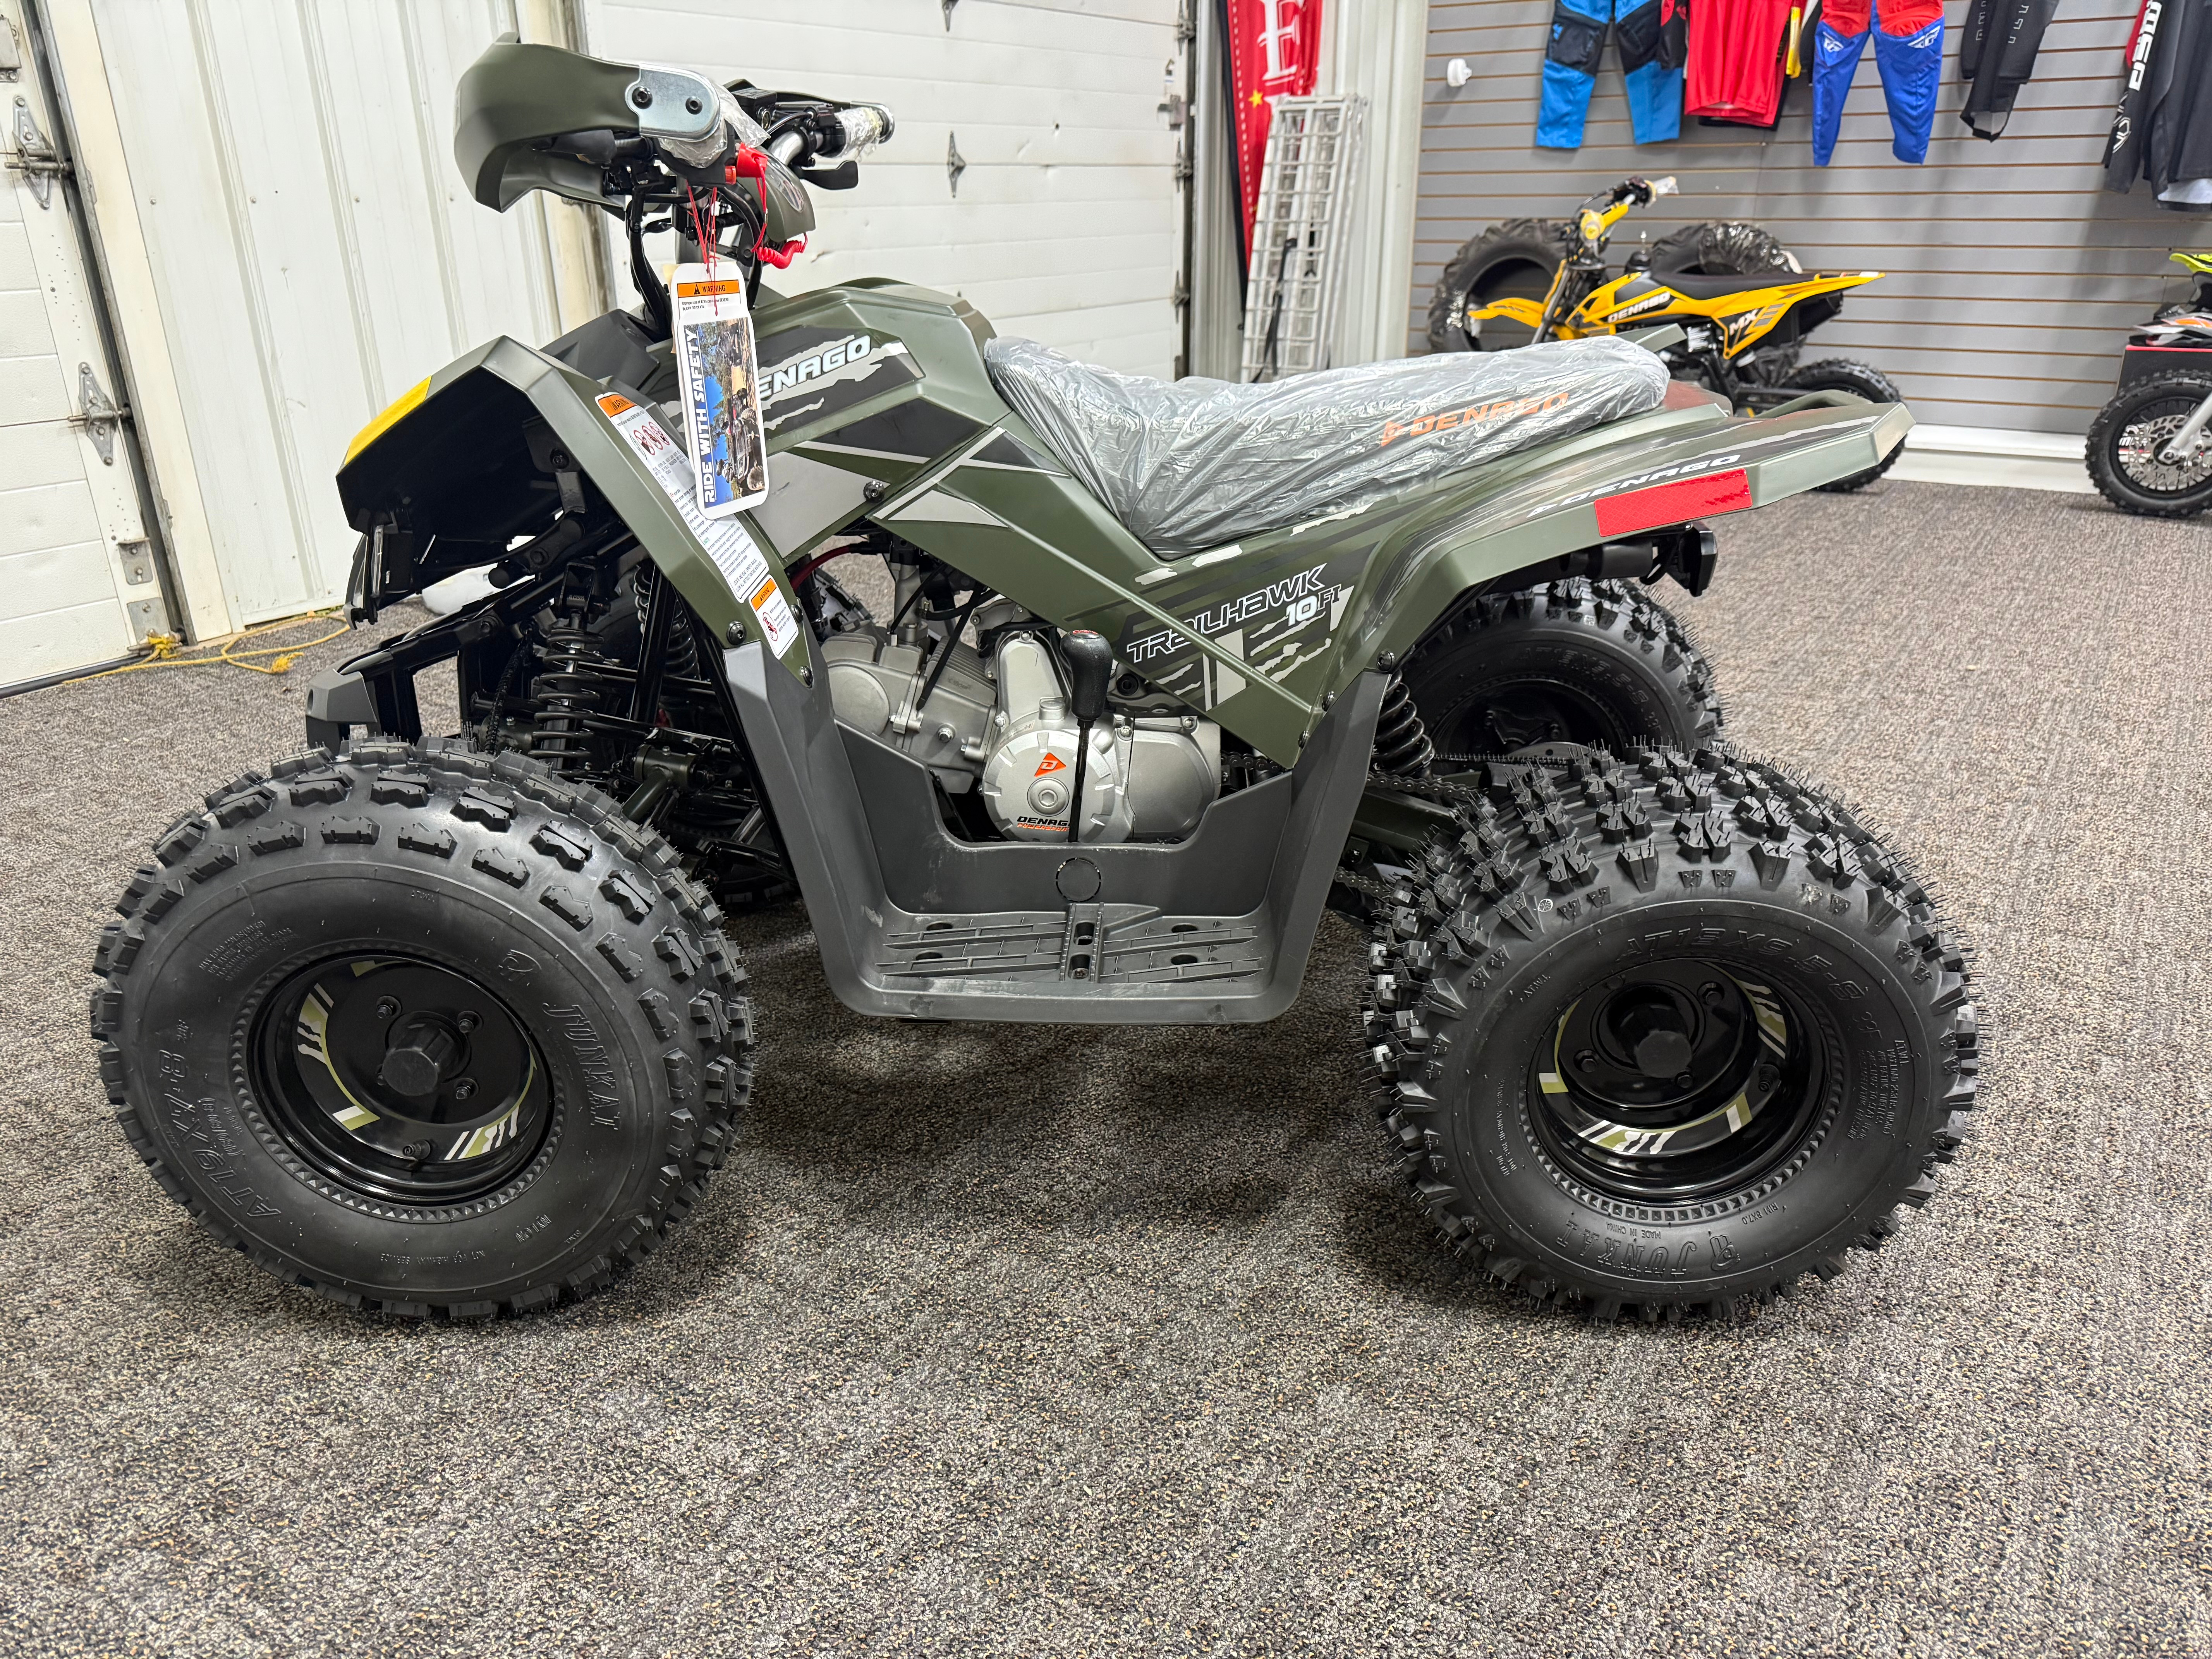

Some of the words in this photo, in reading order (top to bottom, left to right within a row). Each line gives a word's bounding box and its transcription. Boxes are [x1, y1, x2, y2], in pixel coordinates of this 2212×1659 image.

[685, 328, 706, 402] SAFETY
[759, 335, 871, 398] ENAGO
[696, 409, 711, 456] WITH
[703, 461, 715, 503] RIDE
[1558, 454, 1740, 505] DENAGO
[1017, 816, 1070, 827] DENAG
[543, 1001, 620, 1129] JUNKAI
[1741, 1210, 1762, 1225] 8X7.0
[1763, 1202, 1778, 1215] RIM
[514, 1213, 552, 1243] NYLON
[1606, 1221, 1626, 1234] CHINA
[1629, 1228, 1637, 1237] IN
[1640, 1230, 1661, 1239] MADE
[1555, 1219, 1697, 1276] JUNKAI
